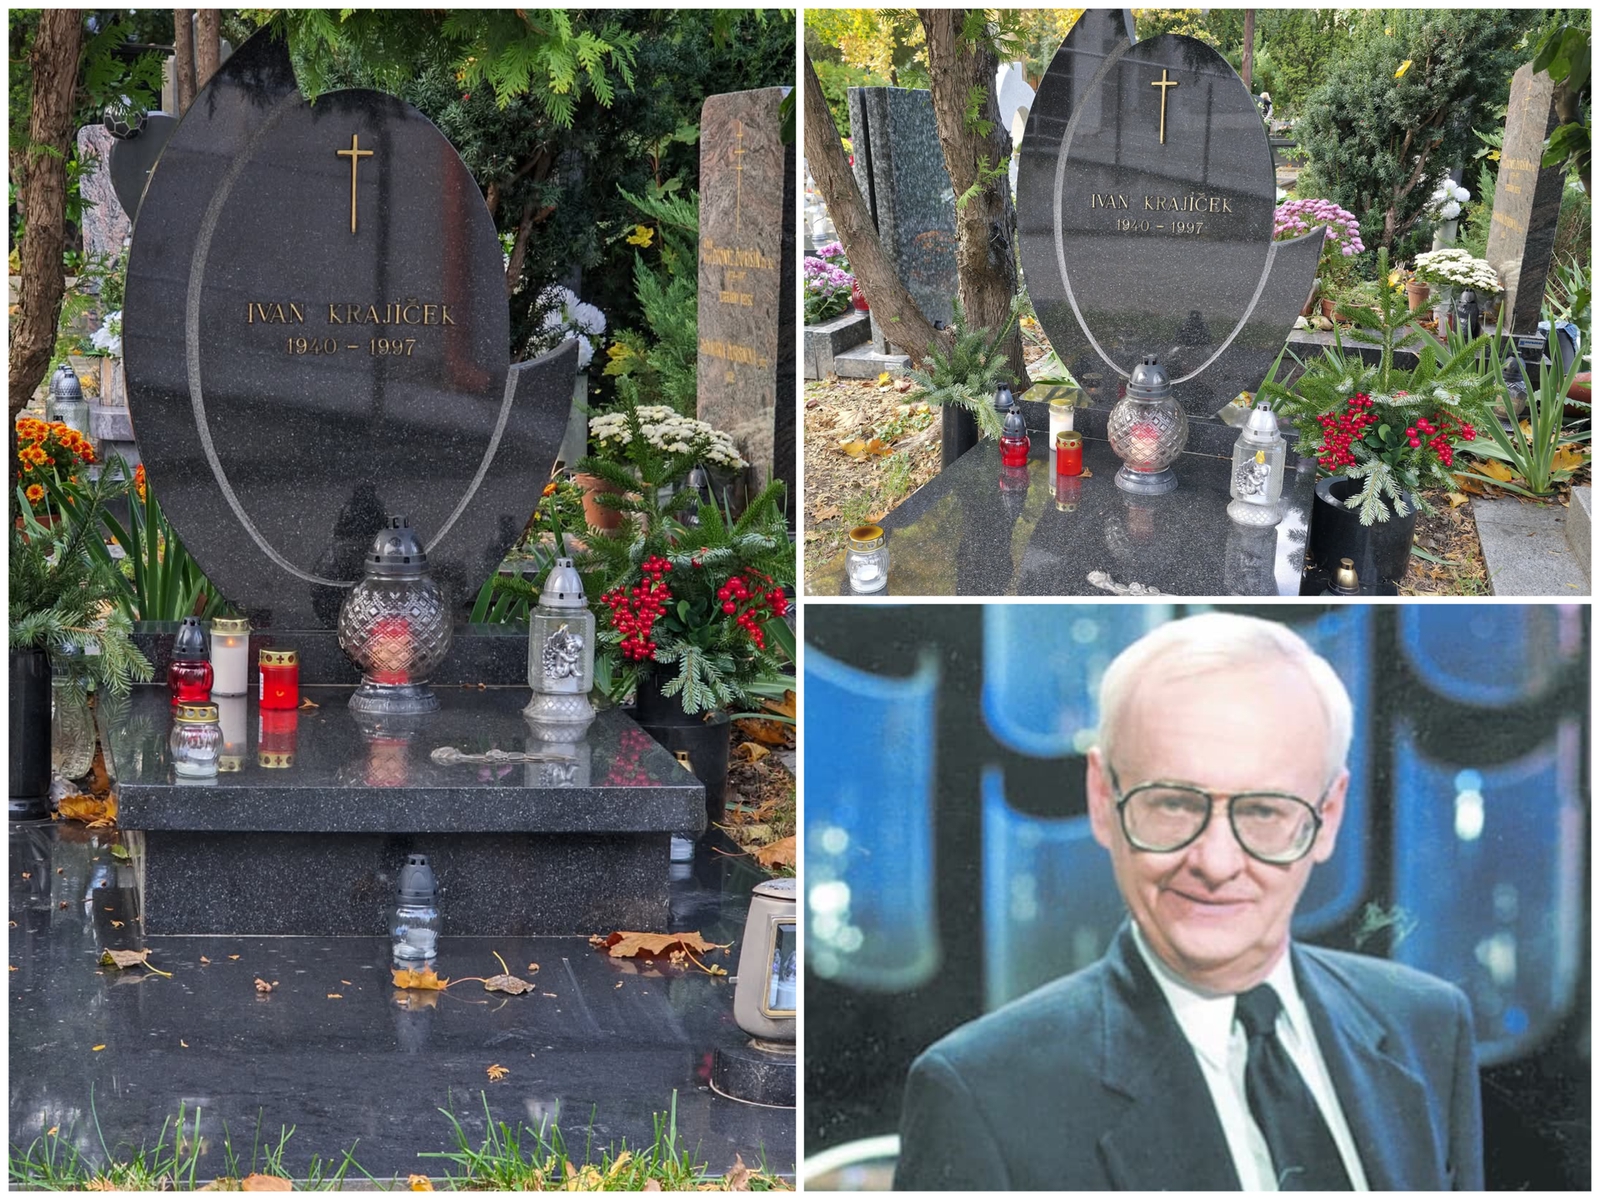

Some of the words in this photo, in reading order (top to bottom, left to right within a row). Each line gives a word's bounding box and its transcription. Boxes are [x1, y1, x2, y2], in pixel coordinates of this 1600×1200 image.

[1091, 193, 1129, 210] IVAN
[1143, 191, 1233, 213] KRAJÍČEK
[1116, 218, 1150, 232] 1940
[1171, 220, 1204, 235] 1997
[247, 302, 305, 325] IVAN
[328, 297, 457, 326] KRAJÍČEK
[286, 337, 338, 356] 1940
[369, 337, 416, 357] 1997
